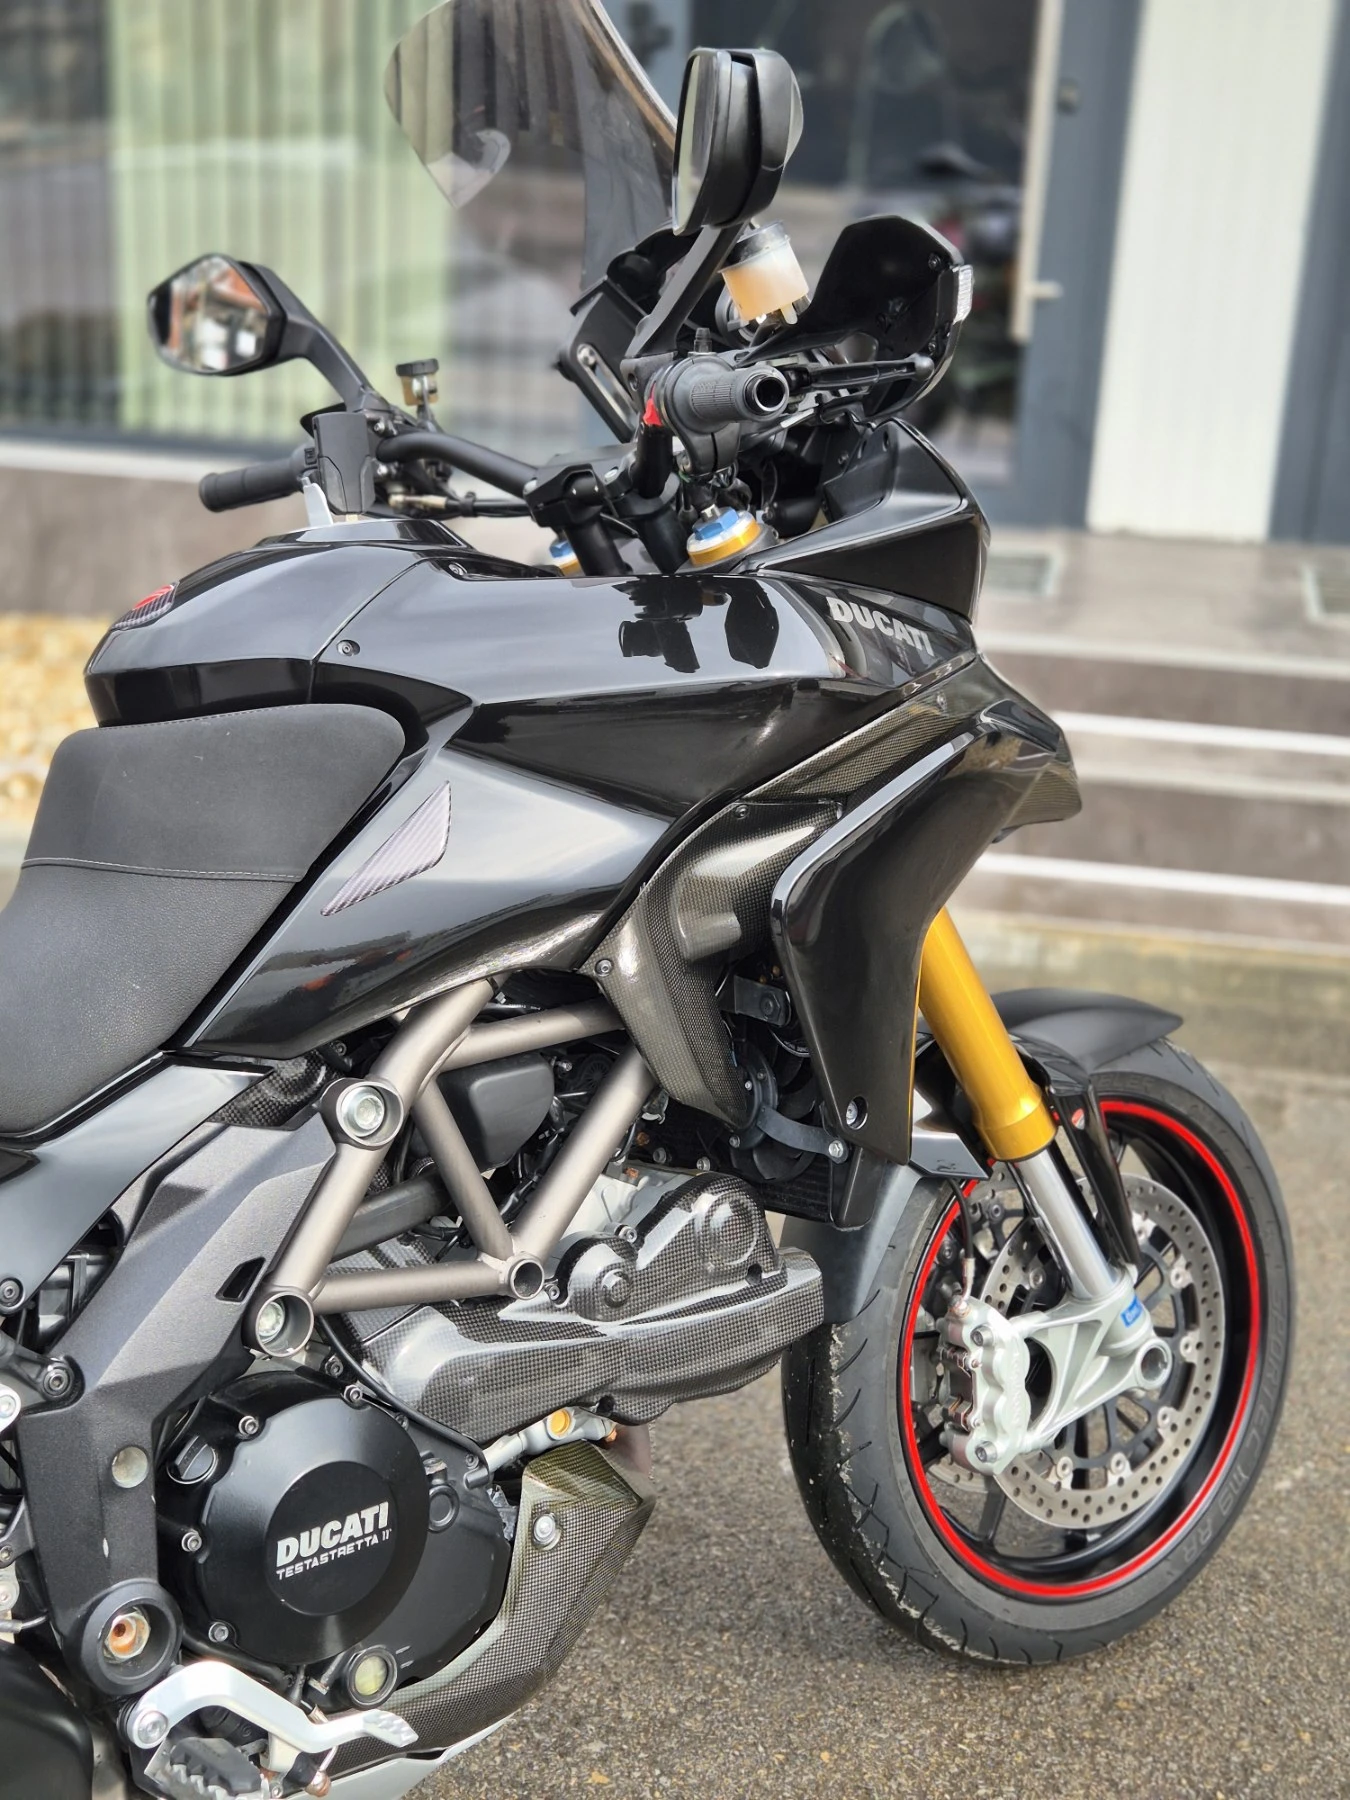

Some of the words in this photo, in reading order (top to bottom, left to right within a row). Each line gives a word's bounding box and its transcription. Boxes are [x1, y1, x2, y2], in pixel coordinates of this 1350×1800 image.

[826, 596, 935, 657] DUCATI
[1244, 1288, 1287, 1458] SPORTEC
[276, 1501, 389, 1567] DUCATI
[276, 1534, 379, 1580] TESTASTRETTA
[1183, 1518, 1213, 1562] RR
